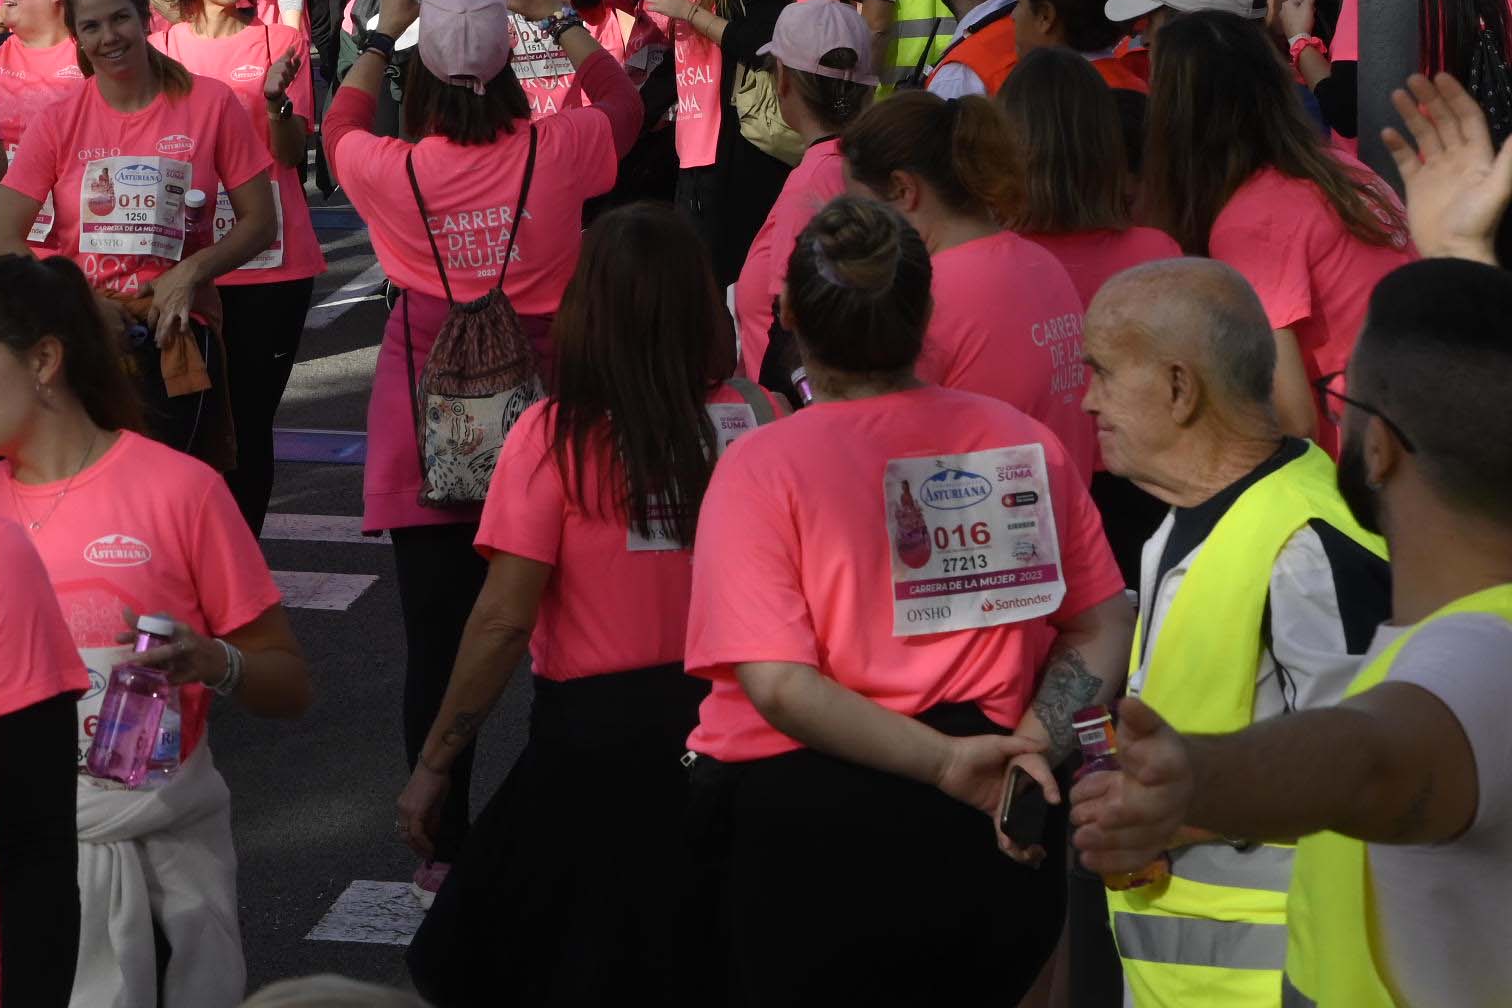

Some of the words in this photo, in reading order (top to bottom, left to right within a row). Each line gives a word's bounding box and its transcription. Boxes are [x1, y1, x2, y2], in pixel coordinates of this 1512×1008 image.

[119, 171, 160, 182] ASTURIANA
[119, 194, 156, 208] 016
[126, 213, 148, 221] 1250
[425, 206, 533, 235] CARRERA
[448, 232, 477, 252] DE
[487, 229, 513, 247] LA
[447, 245, 521, 270] MUJER
[476, 268, 496, 278] 2023
[1050, 342, 1065, 368] DE
[1049, 362, 1086, 395] MUJER
[721, 421, 747, 430] SUMA
[998, 469, 1033, 482] SUMA
[926, 485, 987, 502] ASTURIANA
[934, 521, 991, 550] 016
[89, 547, 147, 560] ASTURIANA
[942, 554, 988, 573] 27213
[909, 583, 948, 594] CARRERA
[948, 581, 962, 591] DE
[965, 580, 977, 589] LA
[980, 574, 1016, 586] MUJER
[907, 605, 952, 623] OYSHO
[995, 593, 1052, 611] Santander
